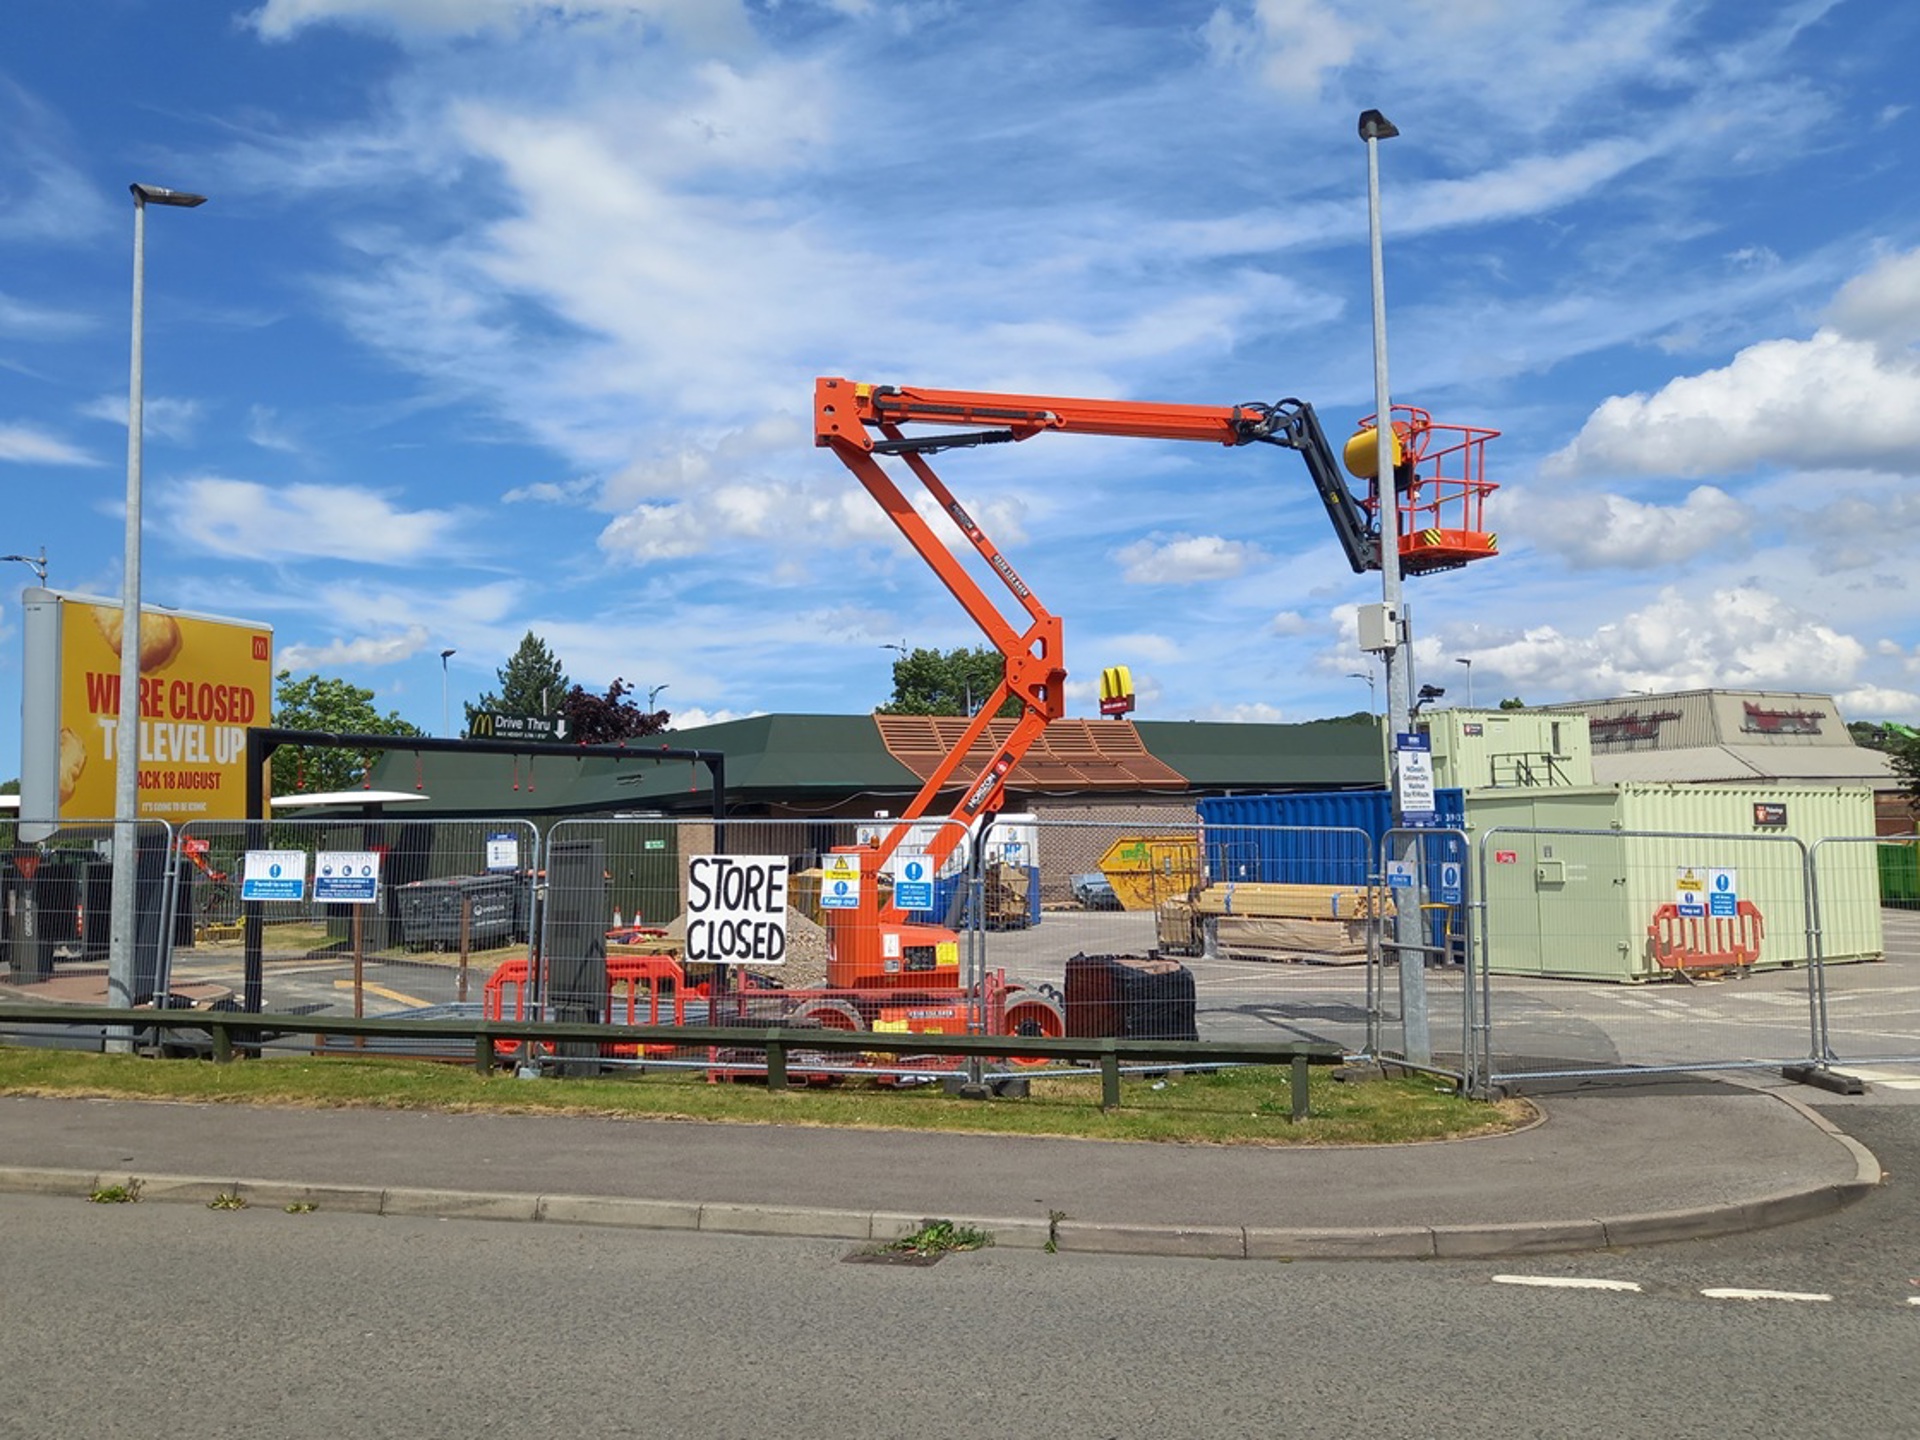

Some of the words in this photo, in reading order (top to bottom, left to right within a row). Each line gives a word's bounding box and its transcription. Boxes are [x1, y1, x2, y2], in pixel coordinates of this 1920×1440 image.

[86, 672, 165, 718] WRE
[169, 679, 256, 724] CLOSED
[140, 721, 211, 764] LEVEL
[214, 726, 246, 765] UP
[494, 714, 524, 730] Drive
[526, 716, 552, 731] Thru
[137, 770, 161, 790] ACK
[162, 771, 175, 790] 18
[176, 772, 222, 791] AUGUST
[687, 857, 787, 913] STORE
[824, 897, 842, 906] Keep
[686, 918, 786, 961] CLOSED
